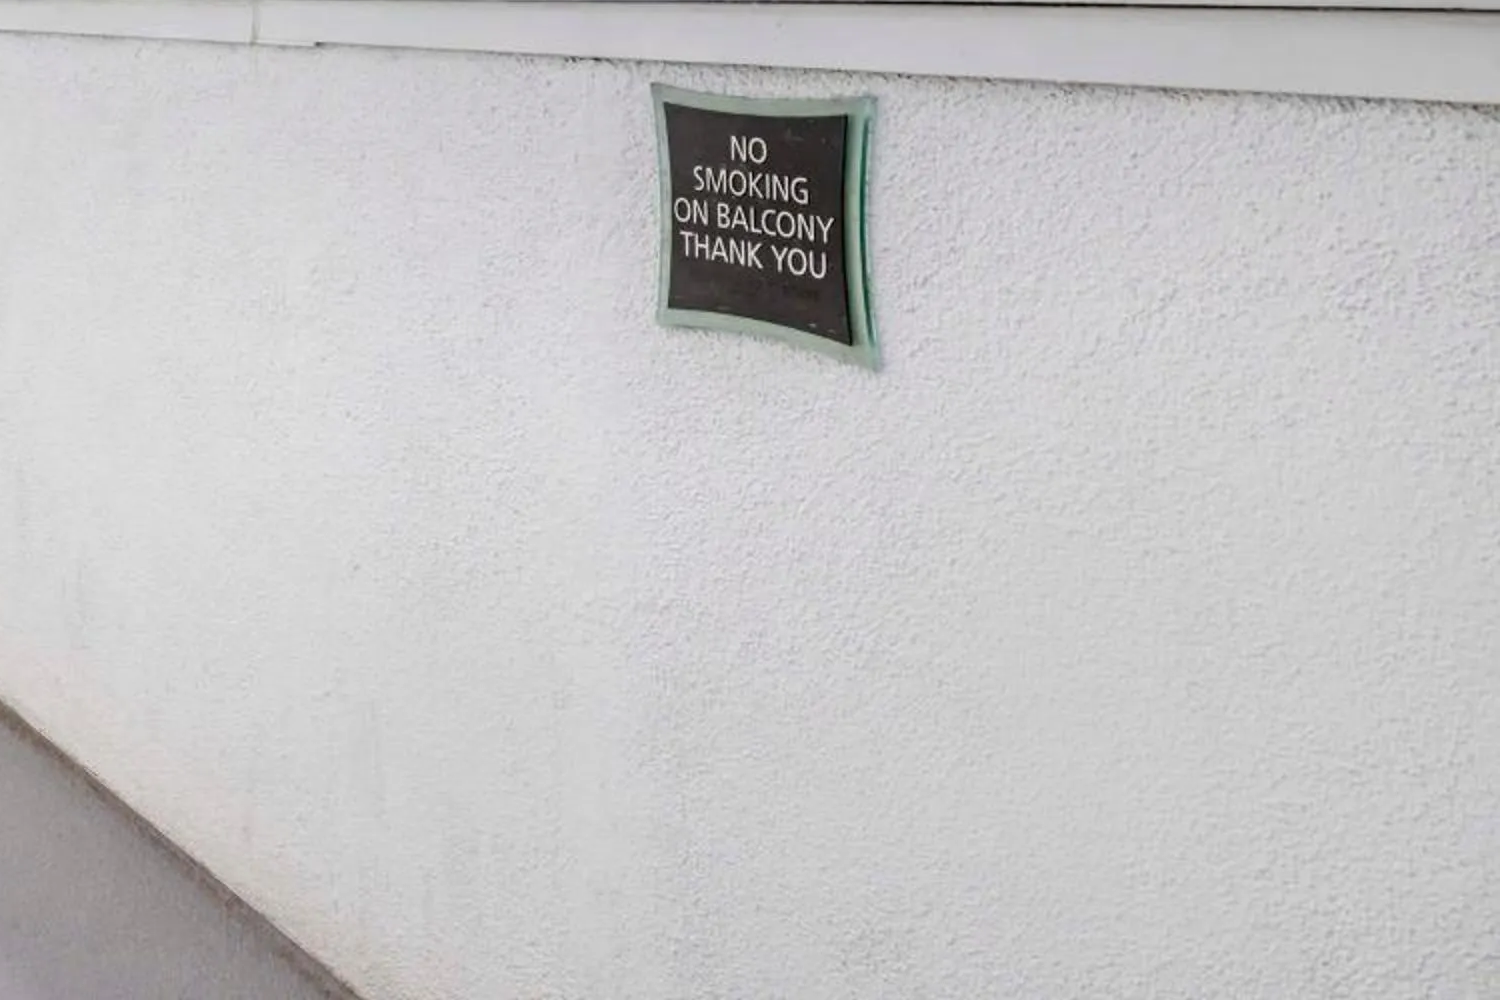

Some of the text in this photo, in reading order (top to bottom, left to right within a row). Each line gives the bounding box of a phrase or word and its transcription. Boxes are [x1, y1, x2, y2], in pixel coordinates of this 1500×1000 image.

[729, 134, 767, 164] NO
[692, 164, 809, 206] SMOKING
[673, 196, 836, 244] ON BALCONY
[679, 230, 828, 279] THANK YOU
